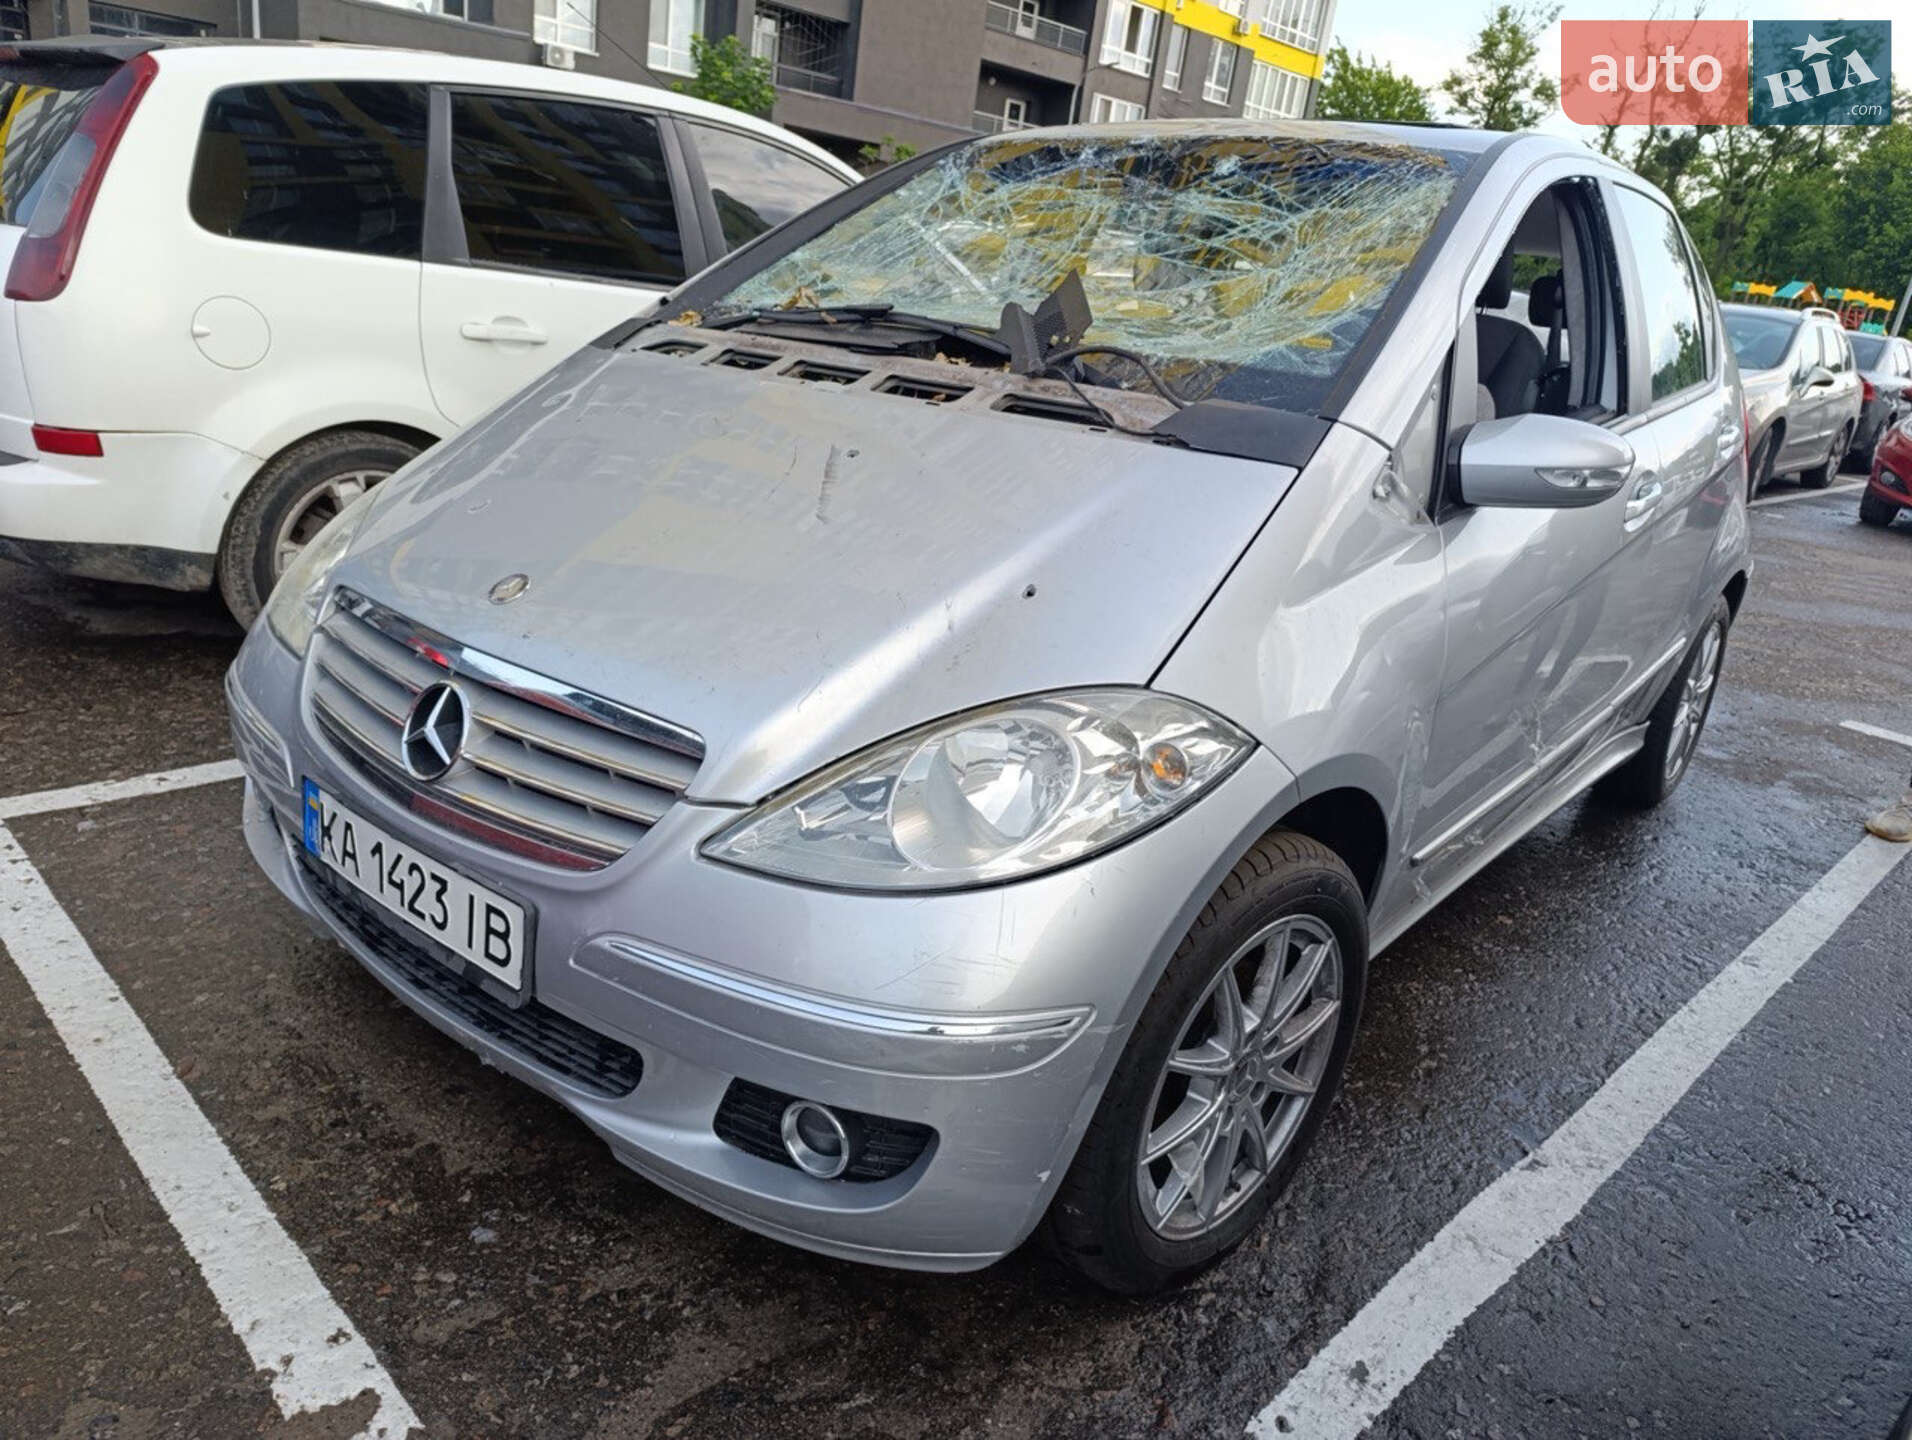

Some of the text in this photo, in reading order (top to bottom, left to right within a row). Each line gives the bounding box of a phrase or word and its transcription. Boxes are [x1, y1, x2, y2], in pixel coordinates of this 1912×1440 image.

[320, 802, 512, 969] KA 1423 IB
